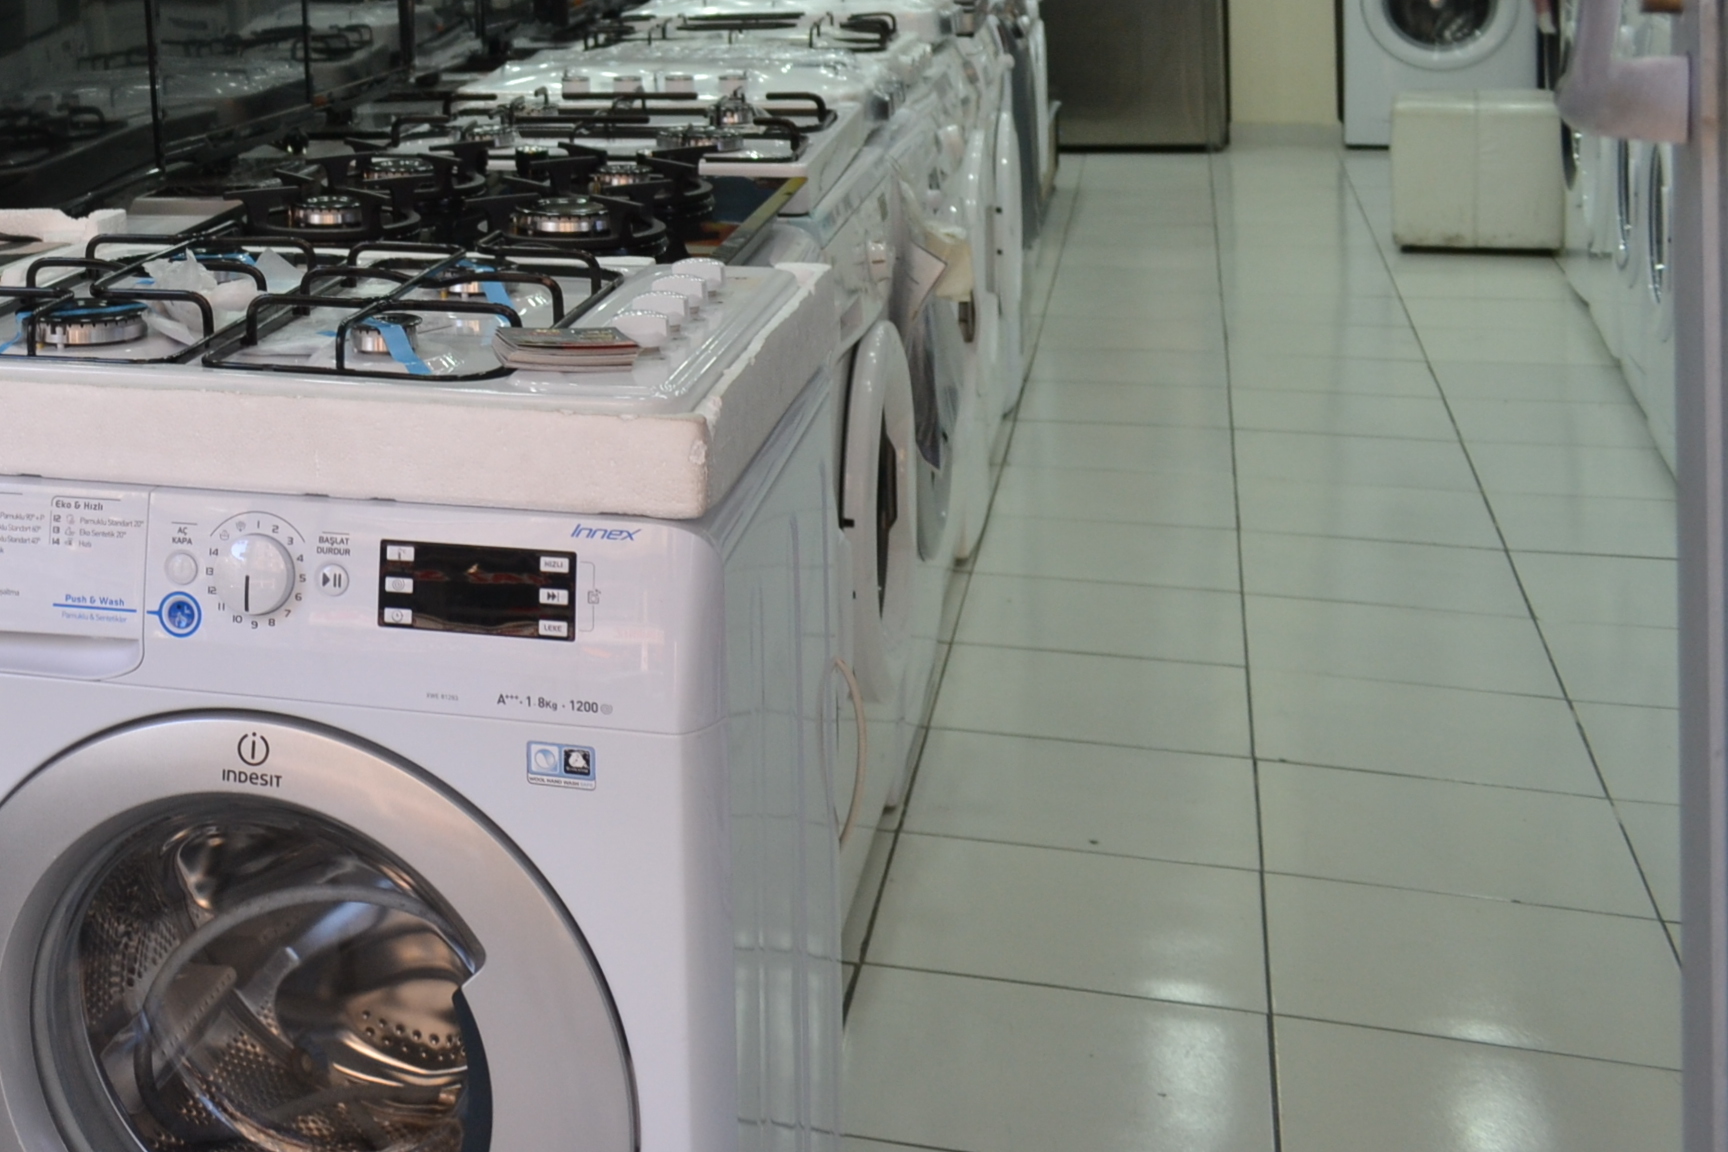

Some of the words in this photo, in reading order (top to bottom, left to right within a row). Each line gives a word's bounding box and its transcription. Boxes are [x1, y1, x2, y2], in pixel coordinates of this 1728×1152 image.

[55, 500, 72, 509] Eko
[74, 501, 81, 509] &
[84, 501, 104, 511] Hızlı
[53, 514, 61, 523] 12
[80, 517, 107, 526] Pamuklu
[108, 519, 133, 527] Standart
[53, 526, 60, 534] 13
[177, 526, 188, 537] AÇ
[271, 524, 279, 533] 2
[571, 523, 642, 541] Innex
[172, 537, 193, 546] KAPA
[286, 537, 294, 546] 3
[318, 536, 350, 546] BAŞLAT
[209, 548, 219, 557] 14
[316, 546, 351, 556] DURDUR
[296, 554, 304, 563] 4
[544, 560, 564, 568] HIZLI
[205, 567, 214, 576] 13
[299, 573, 307, 583] 5
[207, 586, 217, 595] 12
[65, 594, 87, 604] Push
[89, 596, 96, 604] &
[99, 596, 125, 607] Wash
[295, 592, 302, 601] 6
[218, 603, 225, 611] 11
[284, 609, 292, 618] 7
[232, 615, 243, 624] 10
[268, 618, 276, 627] 8
[250, 620, 258, 629] 9
[543, 624, 563, 633] LEKE
[569, 700, 599, 713] 1200
